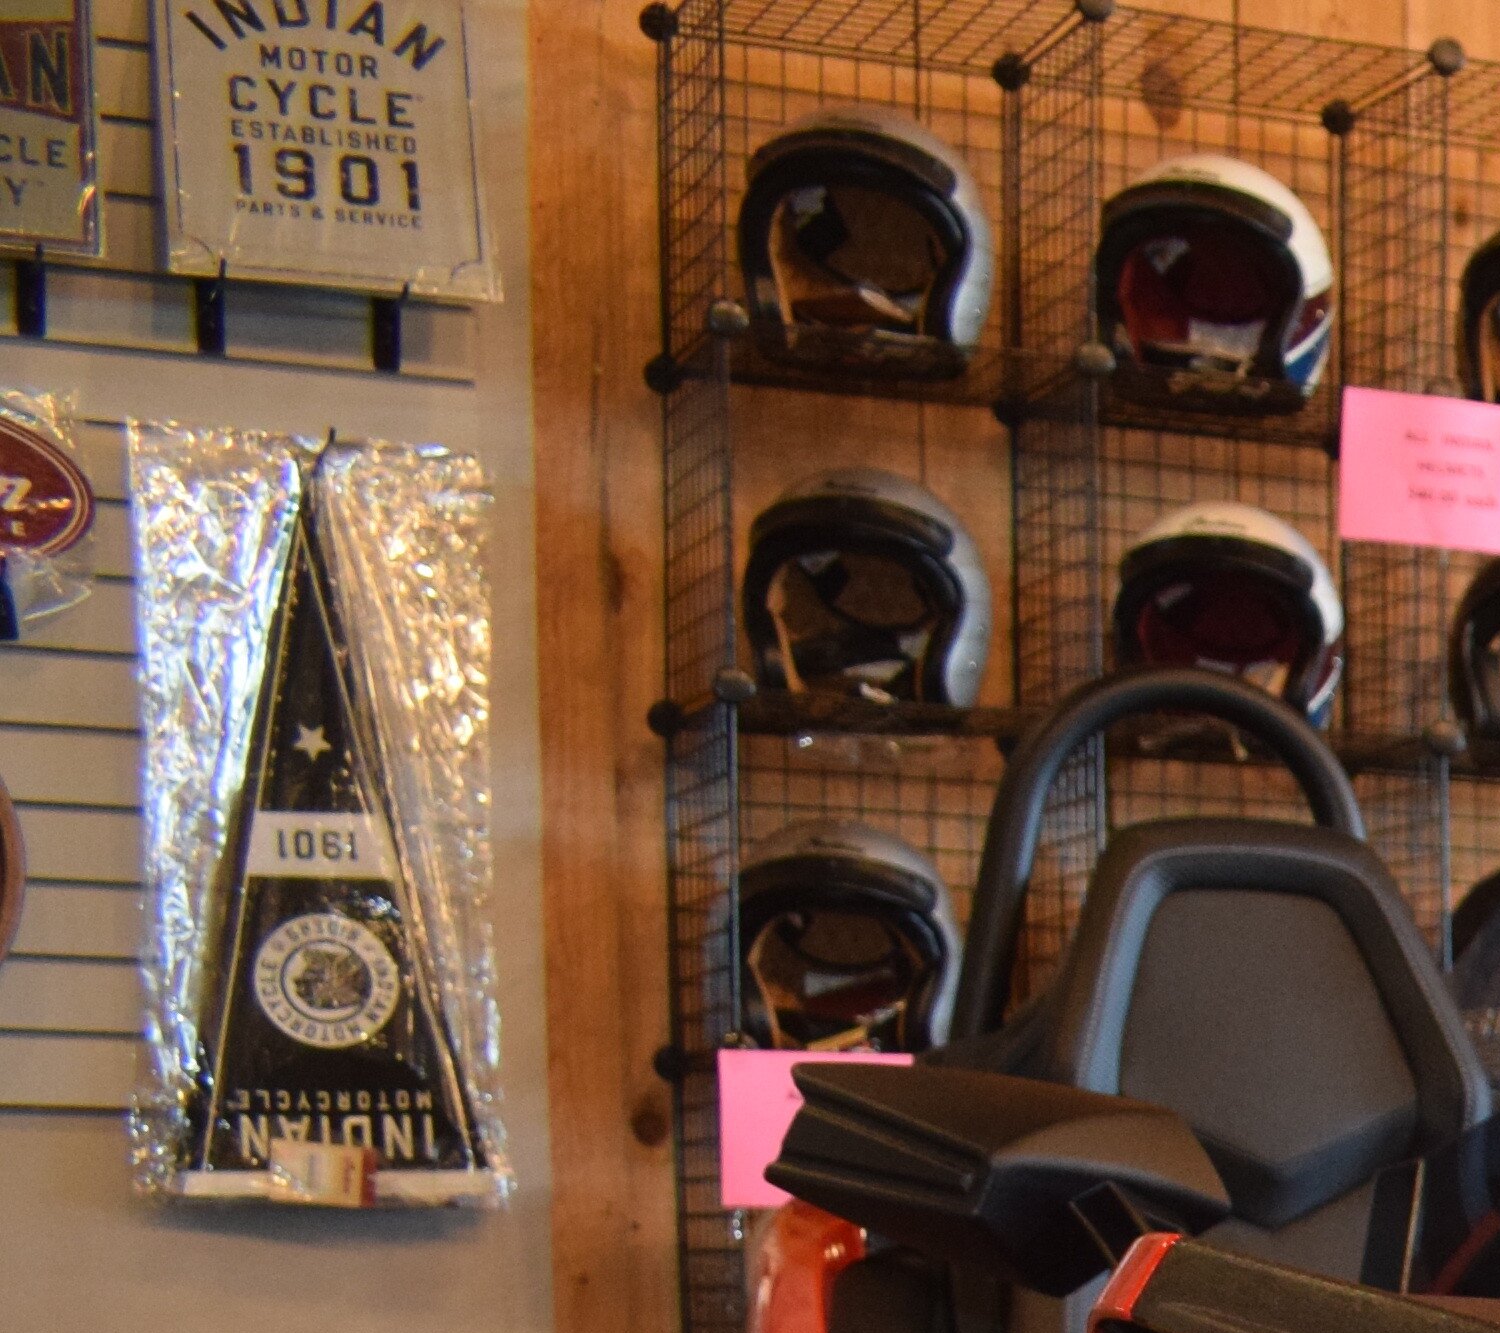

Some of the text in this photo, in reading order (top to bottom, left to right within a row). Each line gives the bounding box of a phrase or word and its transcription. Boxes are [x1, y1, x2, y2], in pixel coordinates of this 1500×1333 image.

[258, 44, 380, 80] MOTOR
[228, 75, 416, 130] CYCLE
[230, 119, 418, 155] ESTABLISHED
[233, 143, 422, 212] 1901
[235, 200, 424, 231] PARTS & SERVICE
[276, 829, 358, 862] 1901
[232, 1087, 434, 1111] MOTORCYCLE
[237, 1113, 440, 1161] INDIAN
